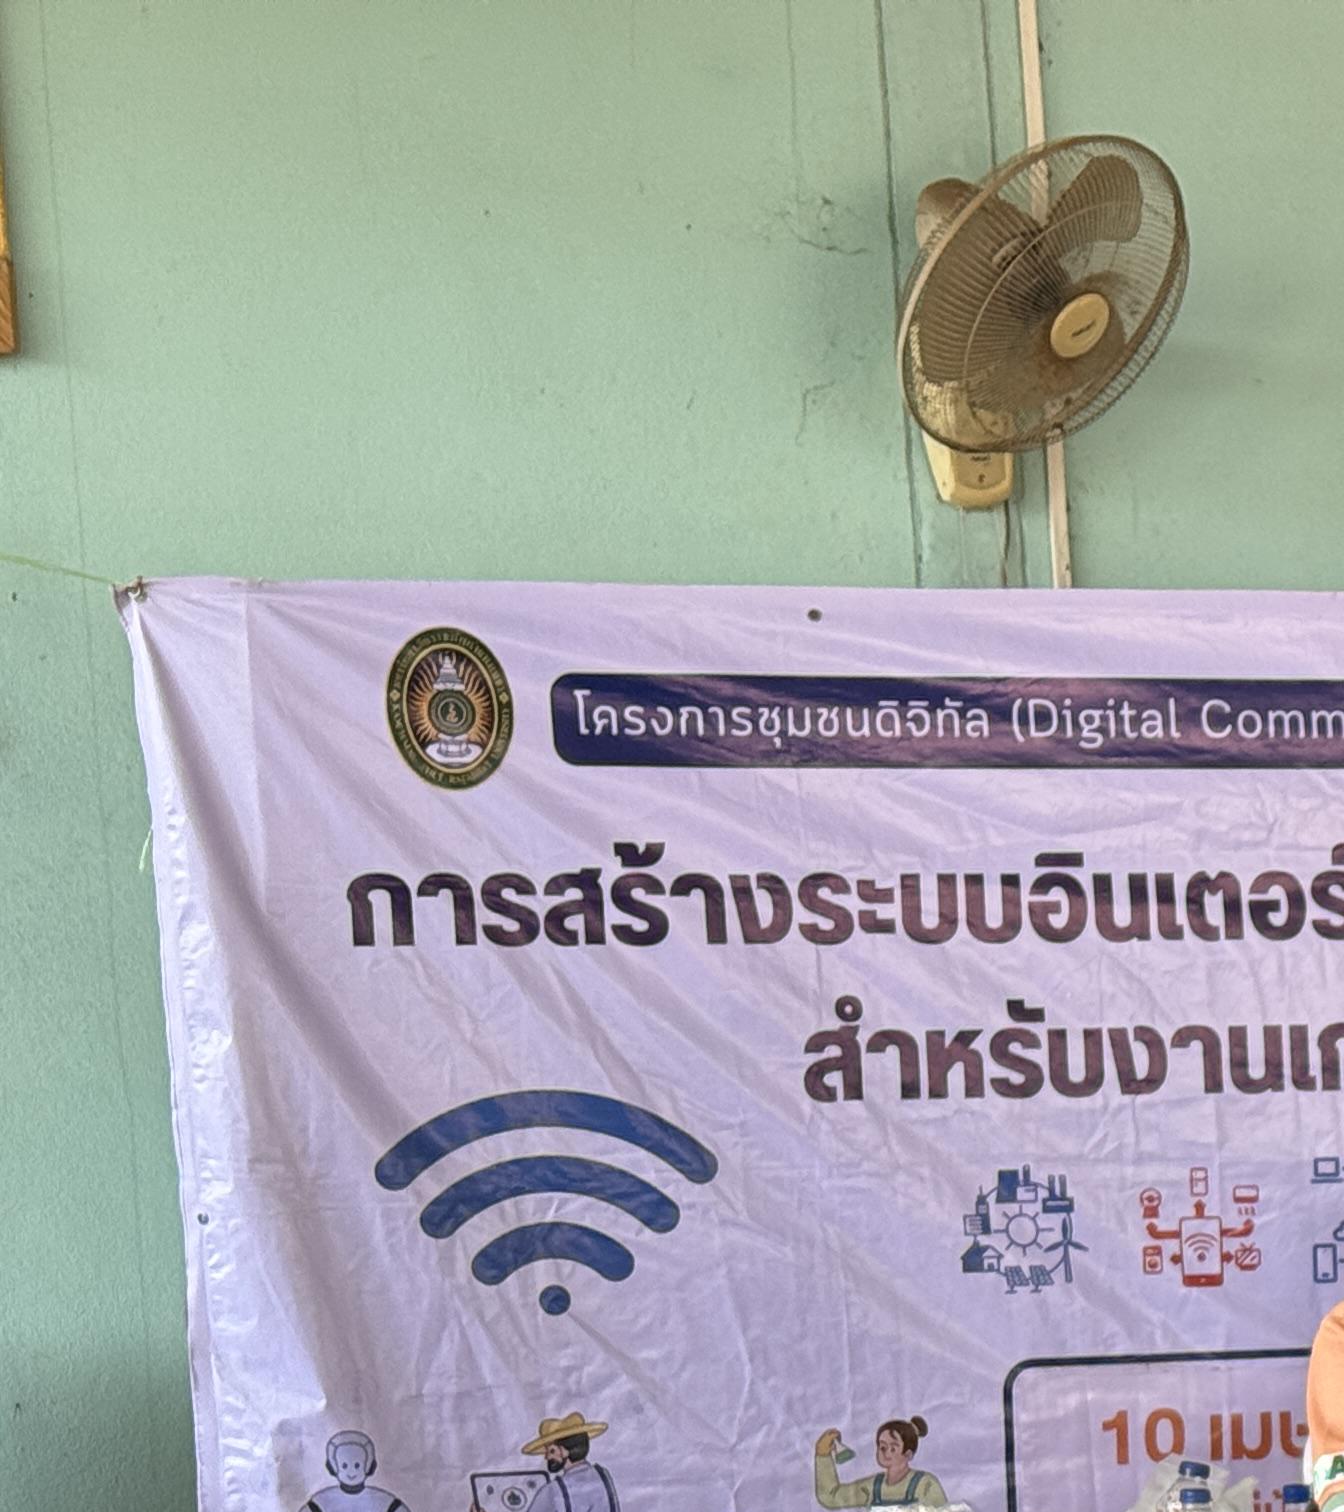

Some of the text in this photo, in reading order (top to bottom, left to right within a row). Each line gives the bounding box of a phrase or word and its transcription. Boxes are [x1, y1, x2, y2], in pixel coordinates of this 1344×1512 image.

[573, 689, 989, 749] โครงการชุมชนดิจิทัล
[1011, 698, 1180, 750] (Digital
[1102, 1407, 1186, 1465] 10
